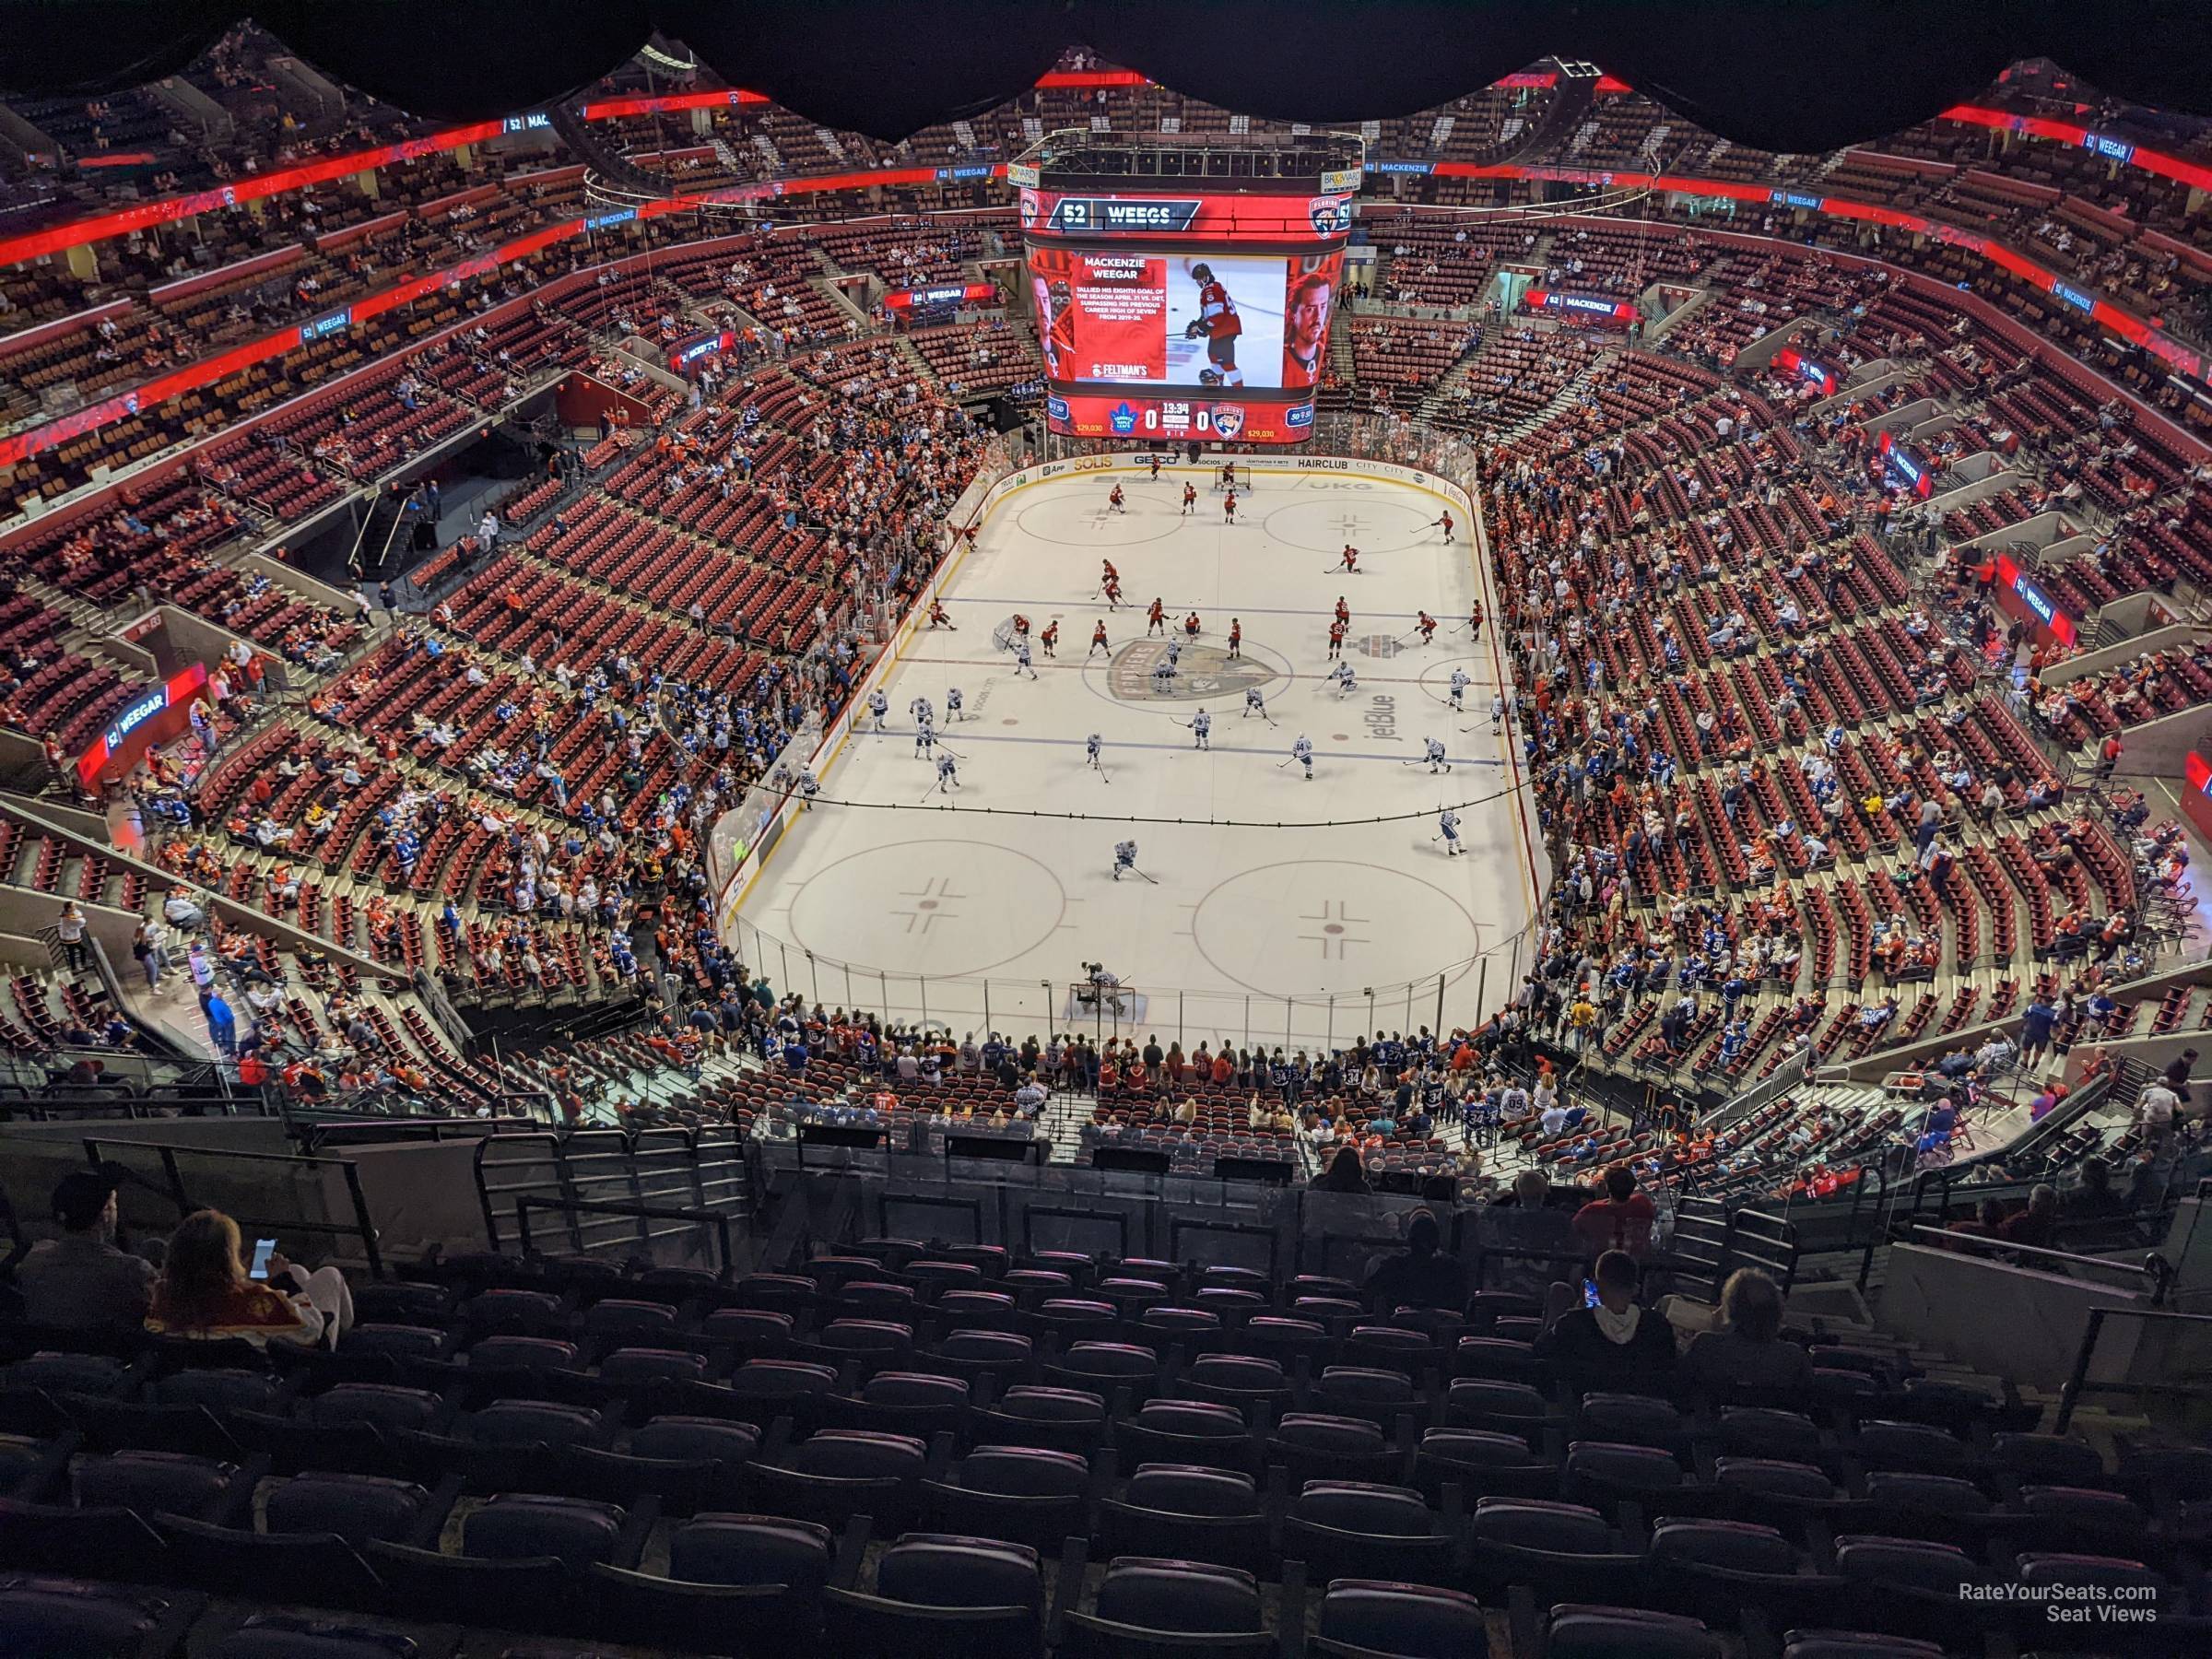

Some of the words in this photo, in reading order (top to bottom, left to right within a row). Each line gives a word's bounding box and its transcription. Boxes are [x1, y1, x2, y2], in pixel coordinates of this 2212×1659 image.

[510, 118, 521, 130] 52
[2086, 135, 2095, 147] 52
[2099, 137, 2126, 159] WEEGAR
[954, 168, 987, 177] WEEGAR
[1382, 164, 1428, 172] MACKENZIE
[1773, 193, 1783, 201] 52
[1788, 194, 1817, 206] WEEGAR
[1064, 205, 1086, 223] 52
[1108, 206, 1170, 224] WEEGS
[1085, 258, 1146, 267] MACKENZIE
[1092, 269, 1137, 279] WEEGAR
[913, 294, 923, 302] 52
[927, 289, 961, 300] WEEGAR
[2064, 288, 2090, 311] MACKENZIE
[1549, 297, 1559, 305] 52
[1567, 298, 1612, 312] MACKENZIE
[303, 327, 312, 338] 52
[316, 314, 347, 332] WEEGAR
[1103, 364, 1147, 376] FELTMAN'S
[1163, 402, 1189, 414] 13:34
[1145, 409, 1158, 429] 0
[1197, 411, 1209, 431] 0
[1077, 424, 1102, 432] $29,030
[1248, 429, 1275, 438] $29,030
[1074, 456, 1112, 471] SOLIS
[1298, 458, 1347, 469] HAIRCLUB
[1309, 482, 1373, 490] UKG
[2016, 578, 2024, 594] 52
[2027, 588, 2052, 621] WEEGAR
[108, 731, 118, 747] 52
[120, 694, 164, 734] WEEGAR
[1364, 694, 1403, 742] jetBlue
[1347, 1071, 1359, 1082] 34
[1429, 1089, 1441, 1103] 34
